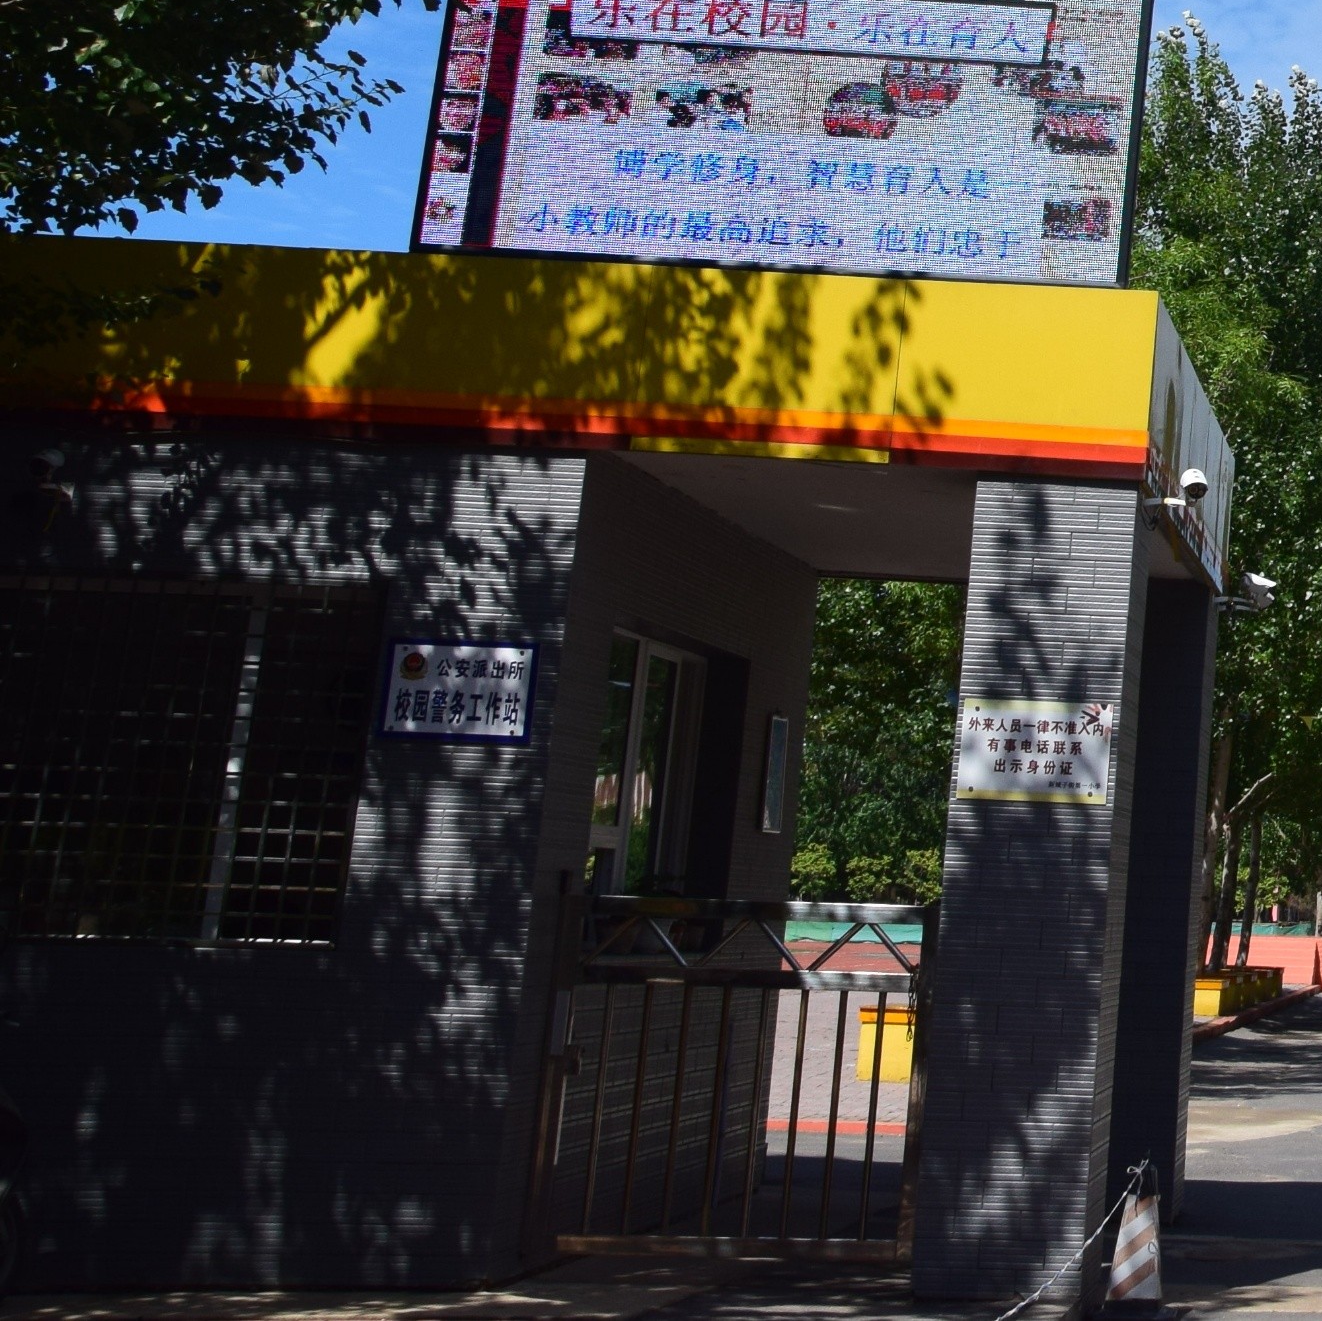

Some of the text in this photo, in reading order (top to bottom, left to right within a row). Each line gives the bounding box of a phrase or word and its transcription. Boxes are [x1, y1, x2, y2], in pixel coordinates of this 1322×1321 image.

[437, 658, 525, 680] 公安派出所
[394, 688, 520, 726] 校园警务工作站
[968, 716, 1104, 737] 外来人员一律不准入内
[987, 737, 1083, 756] 有事电话联系
[993, 758, 1073, 776] 出示身份证
